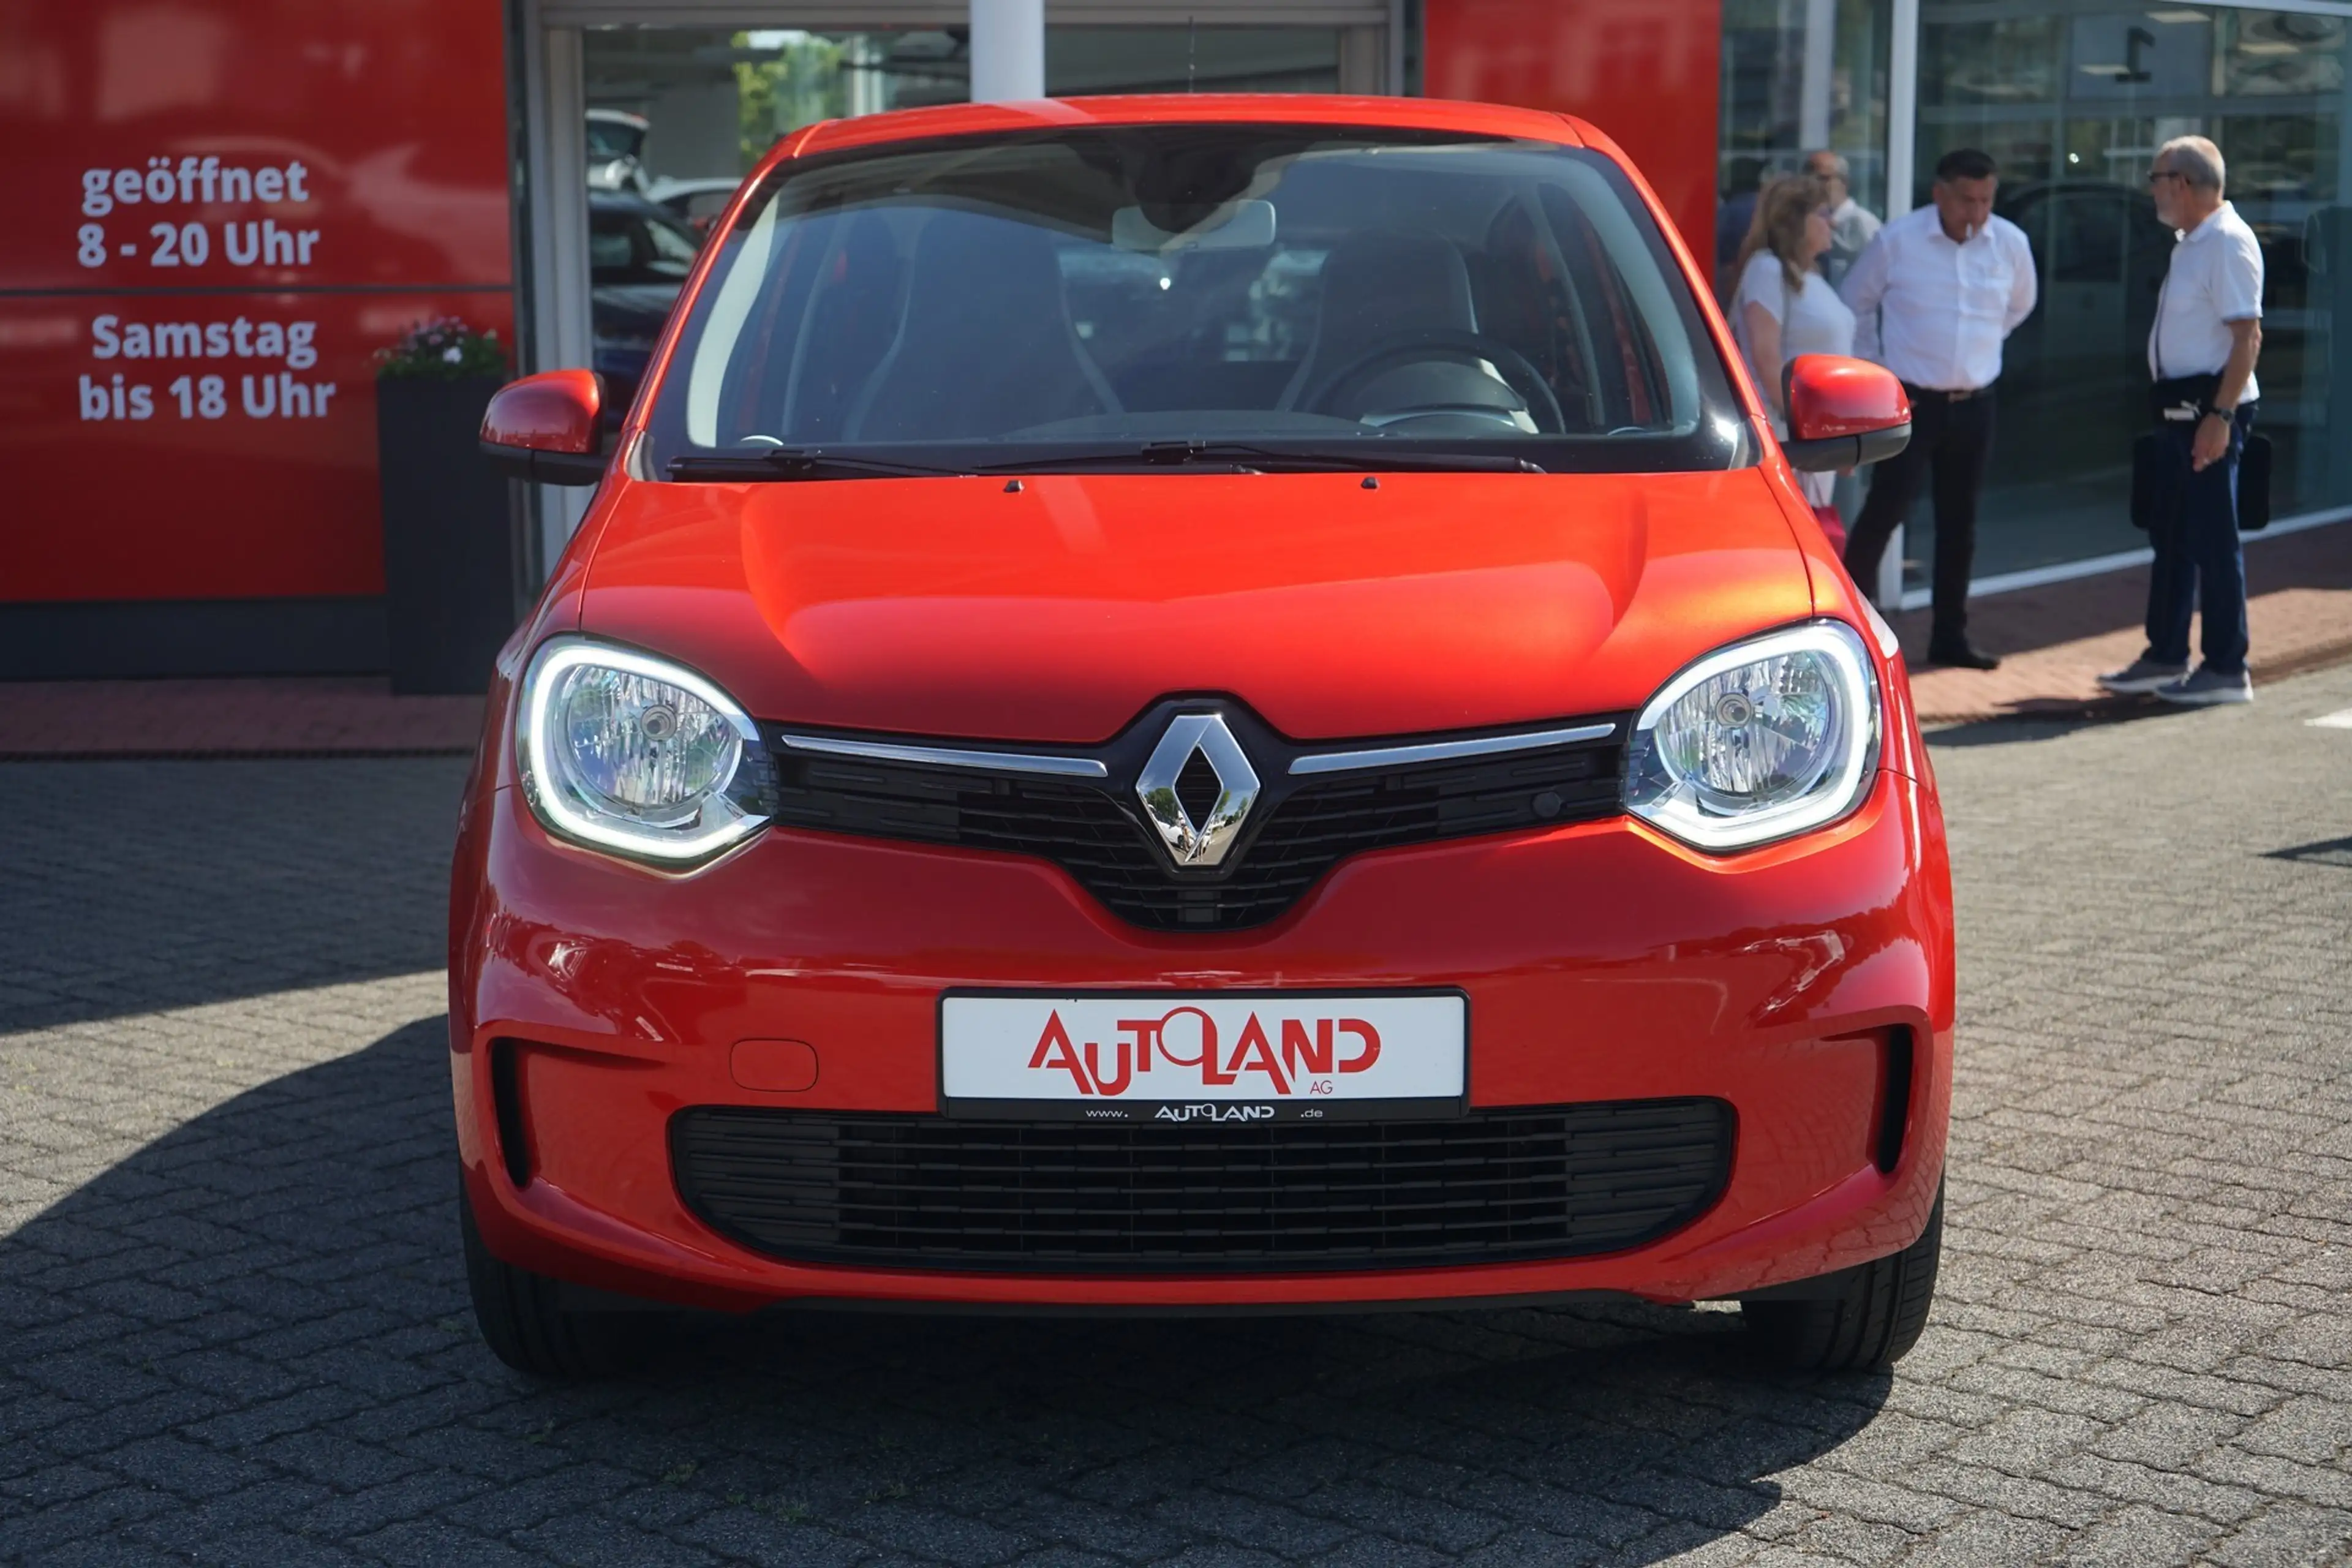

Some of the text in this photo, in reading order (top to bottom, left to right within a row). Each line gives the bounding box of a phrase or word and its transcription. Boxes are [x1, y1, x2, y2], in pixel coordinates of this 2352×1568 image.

[82, 156, 309, 217] geöffnet
[78, 219, 320, 268] 8 - 20 Uhr
[92, 314, 317, 369] Samstag
[79, 372, 336, 420] bis 18 Uhr
[1028, 1006, 1381, 1096] AUTOLAND
[1310, 1080, 1333, 1095] AG
[1085, 1103, 1323, 1122] www. AUTOLAND .de
